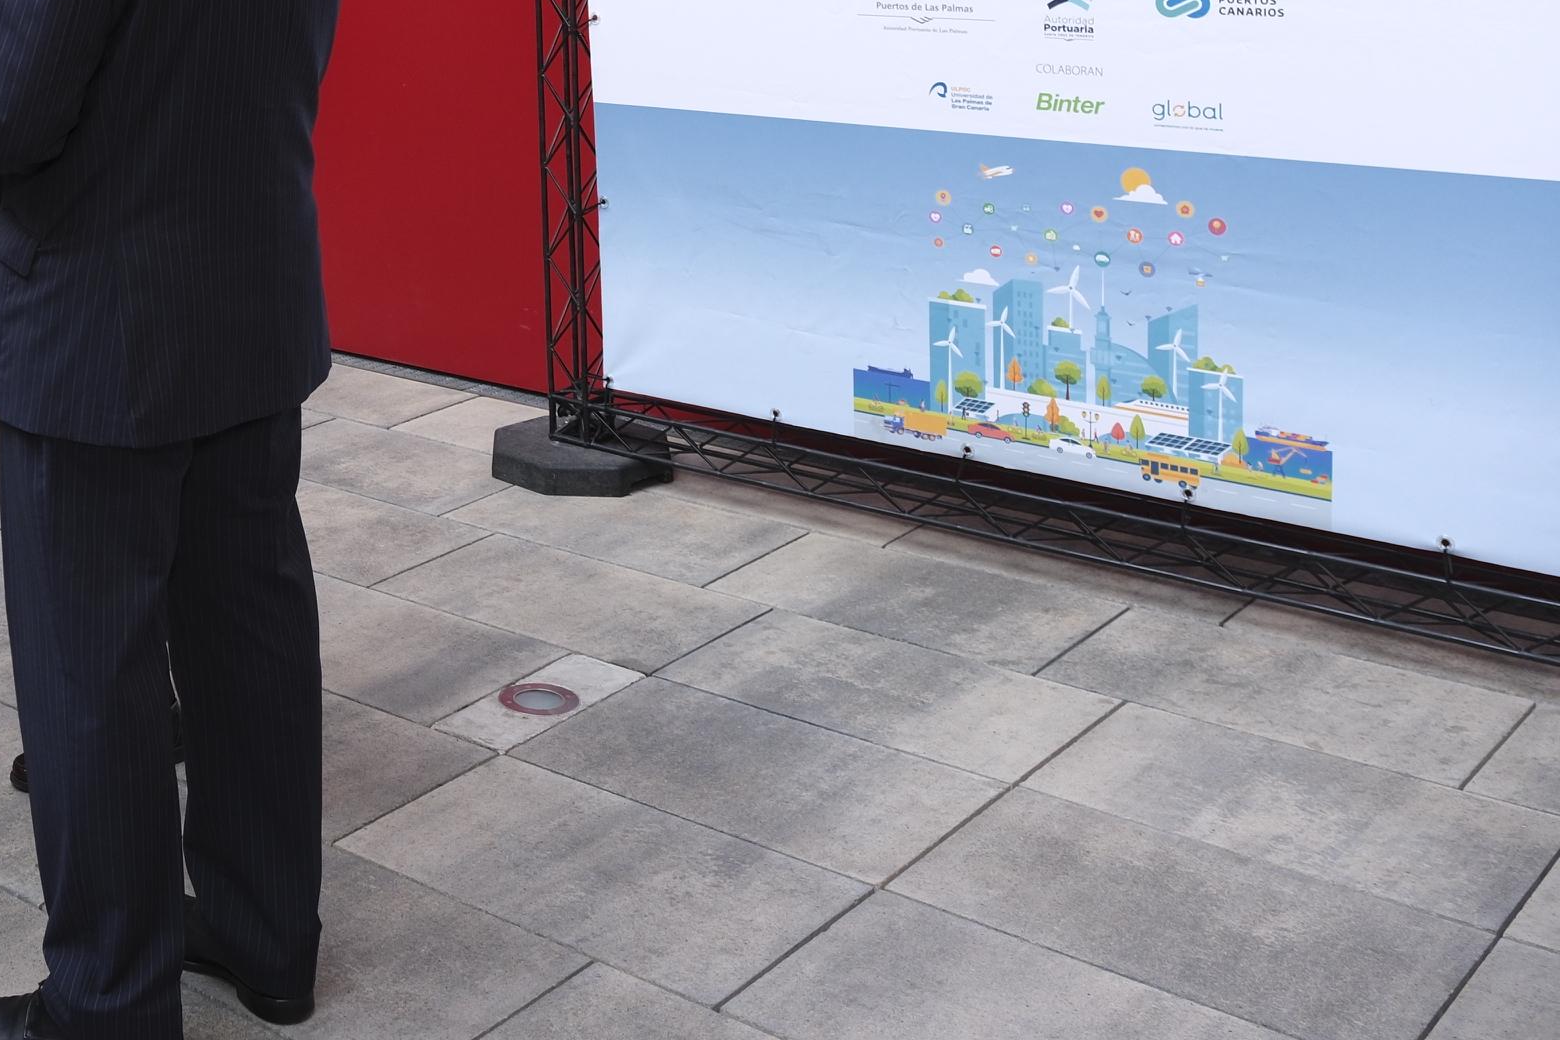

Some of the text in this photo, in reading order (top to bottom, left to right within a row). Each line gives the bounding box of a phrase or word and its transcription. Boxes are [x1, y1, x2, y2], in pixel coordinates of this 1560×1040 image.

[876, 1, 974, 14] Puertos de Las Palmas
[1218, 6, 1285, 18] CANARIOS
[1044, 15, 1095, 26] Autoridad
[1043, 23, 1094, 34] Portuaria
[1035, 63, 1104, 77] COLABORAN
[1036, 92, 1105, 114] Binter
[1152, 100, 1224, 121] global
